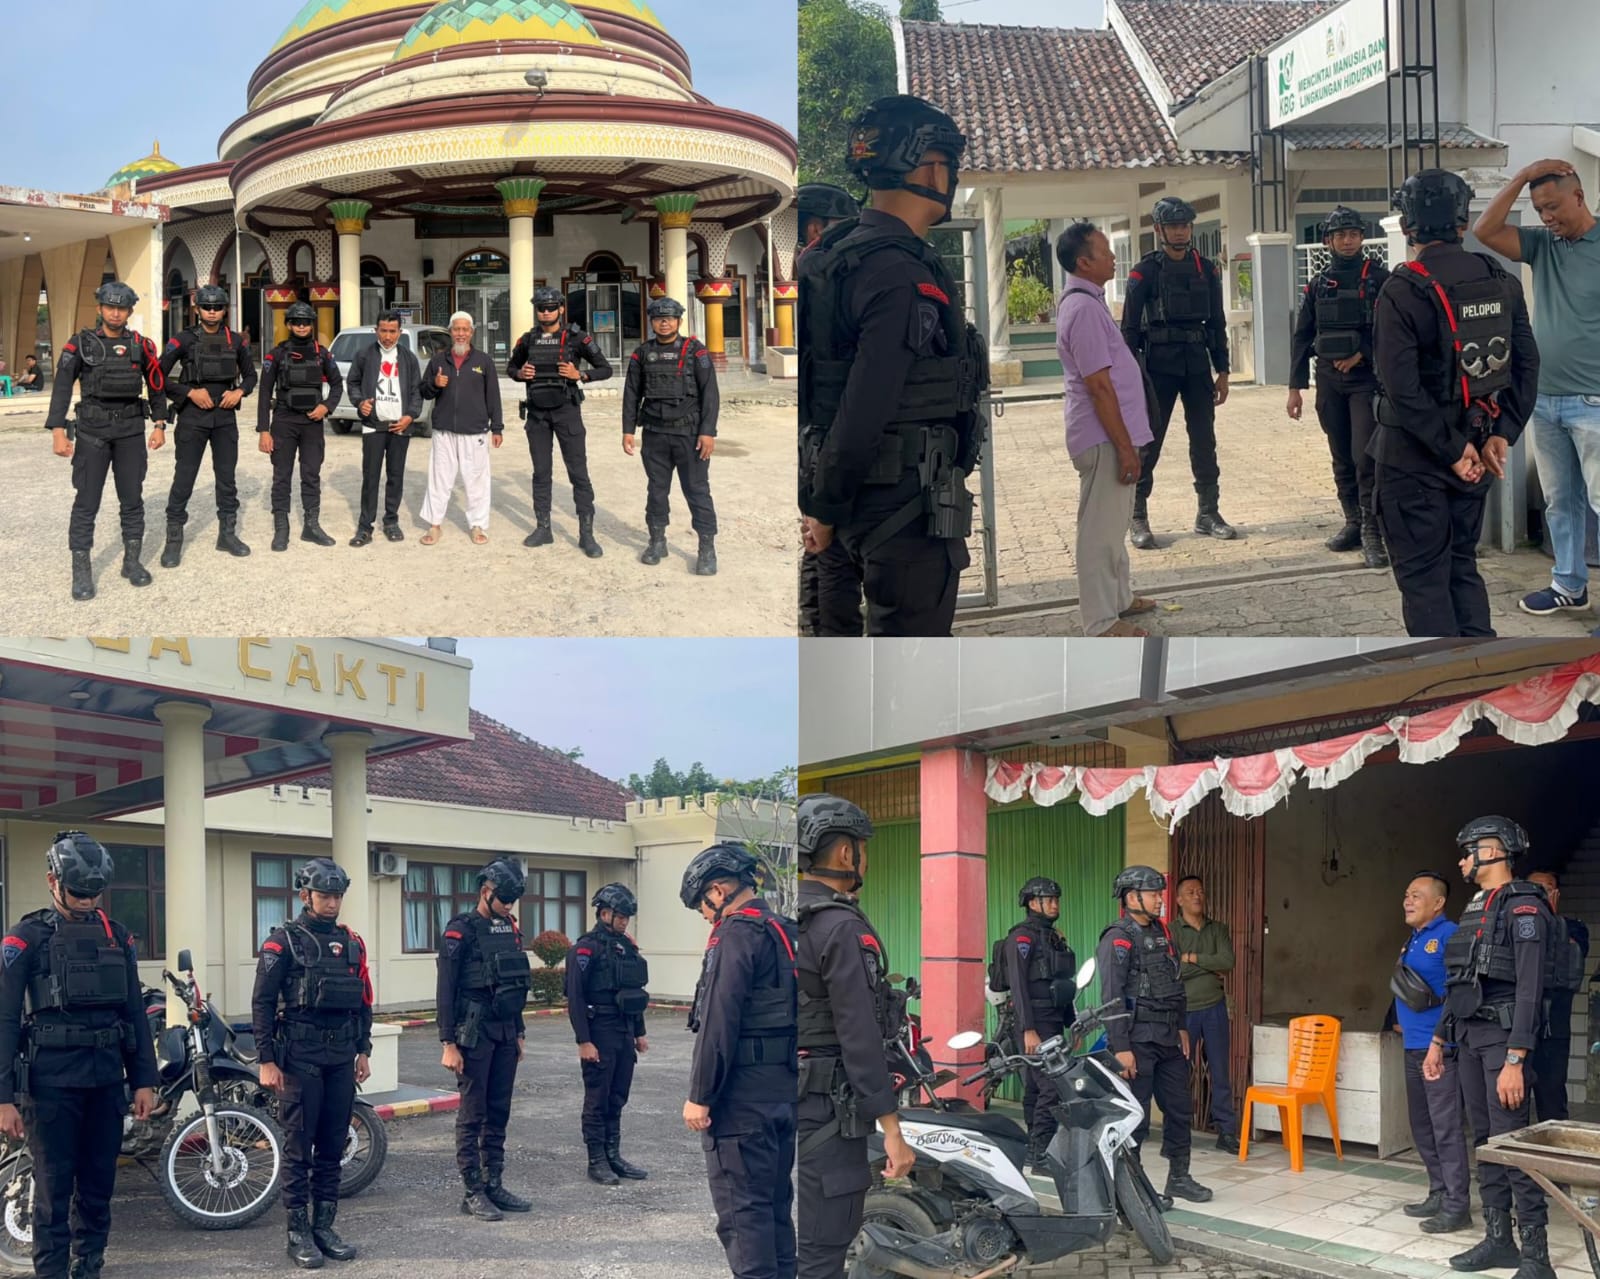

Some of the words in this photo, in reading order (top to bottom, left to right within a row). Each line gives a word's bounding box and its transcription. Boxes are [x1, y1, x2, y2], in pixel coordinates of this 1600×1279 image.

[1298, 66, 1332, 92] MENCINTAI
[1333, 47, 1367, 75] MANUSIA
[1368, 37, 1386, 57] DAN
[1299, 82, 1342, 108] LINGKUNGAN
[1343, 59, 1383, 88] HIDUPNYA
[1279, 94, 1295, 117] KBG
[1462, 302, 1501, 318] PELOPOR
